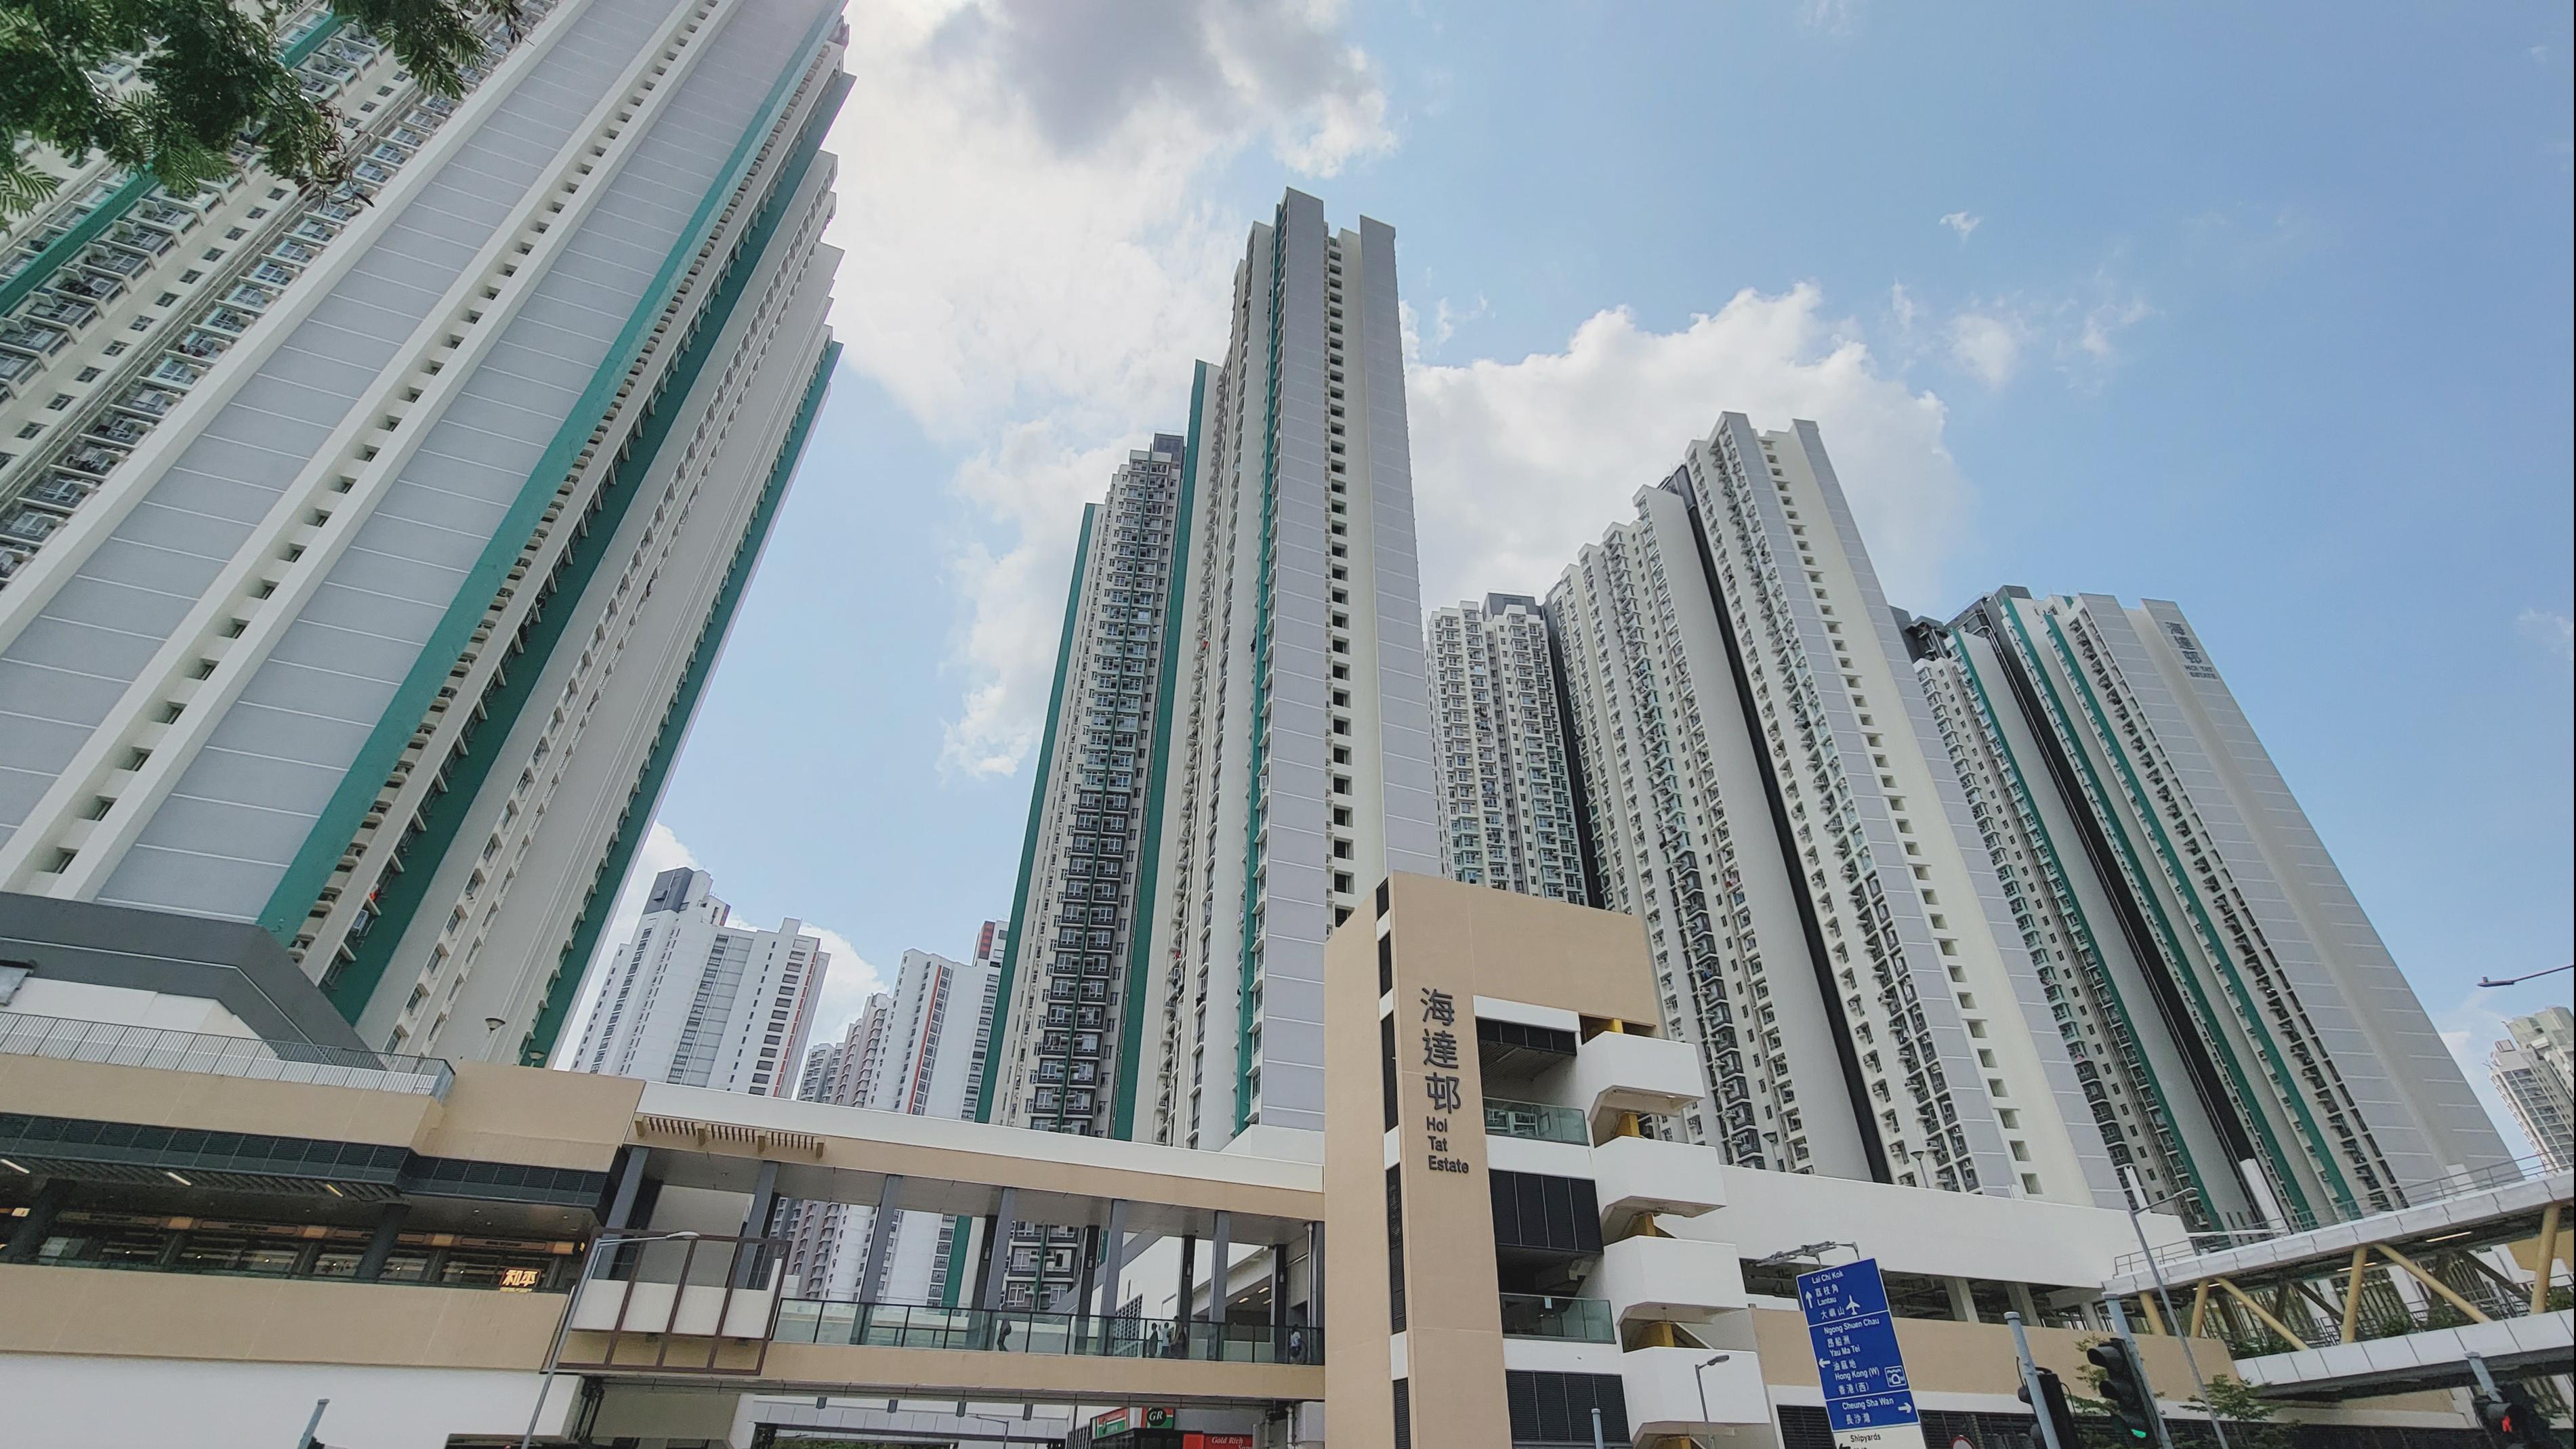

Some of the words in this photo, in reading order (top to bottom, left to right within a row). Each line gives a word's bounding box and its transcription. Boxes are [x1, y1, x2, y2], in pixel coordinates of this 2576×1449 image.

[1420, 987, 1461, 1114] 海達邨
[1426, 1115, 1448, 1133] Hoi
[1428, 1135, 1449, 1152] Tat
[1428, 1154, 1470, 1174] Estate
[502, 1269, 539, 1287] 和平
[1811, 1276, 1821, 1284] Lai
[1821, 1273, 1831, 1282] Chi
[1831, 1270, 1844, 1280] Kok
[1817, 1297, 1837, 1306] Lantau
[1823, 1326, 1843, 1335] Ngong
[1844, 1321, 1863, 1330] Shuen
[1863, 1318, 1880, 1326] Chau
[1829, 1349, 1841, 1357] Yau
[1850, 1344, 1861, 1353] Tei
[1835, 1372, 1852, 1381] Hong
[1852, 1369, 1868, 1379] Kong
[1869, 1366, 1879, 1377] (W)
[1842, 1402, 1866, 1410] Cheung
[1865, 1399, 1878, 1407] Sha
[1878, 1397, 1894, 1406] Wan
[1148, 1410, 1163, 1421] GR
[1211, 1436, 1227, 1444] Gold
[1228, 1437, 1243, 1445] Rich
[1850, 1433, 1881, 1443] Shipyards
